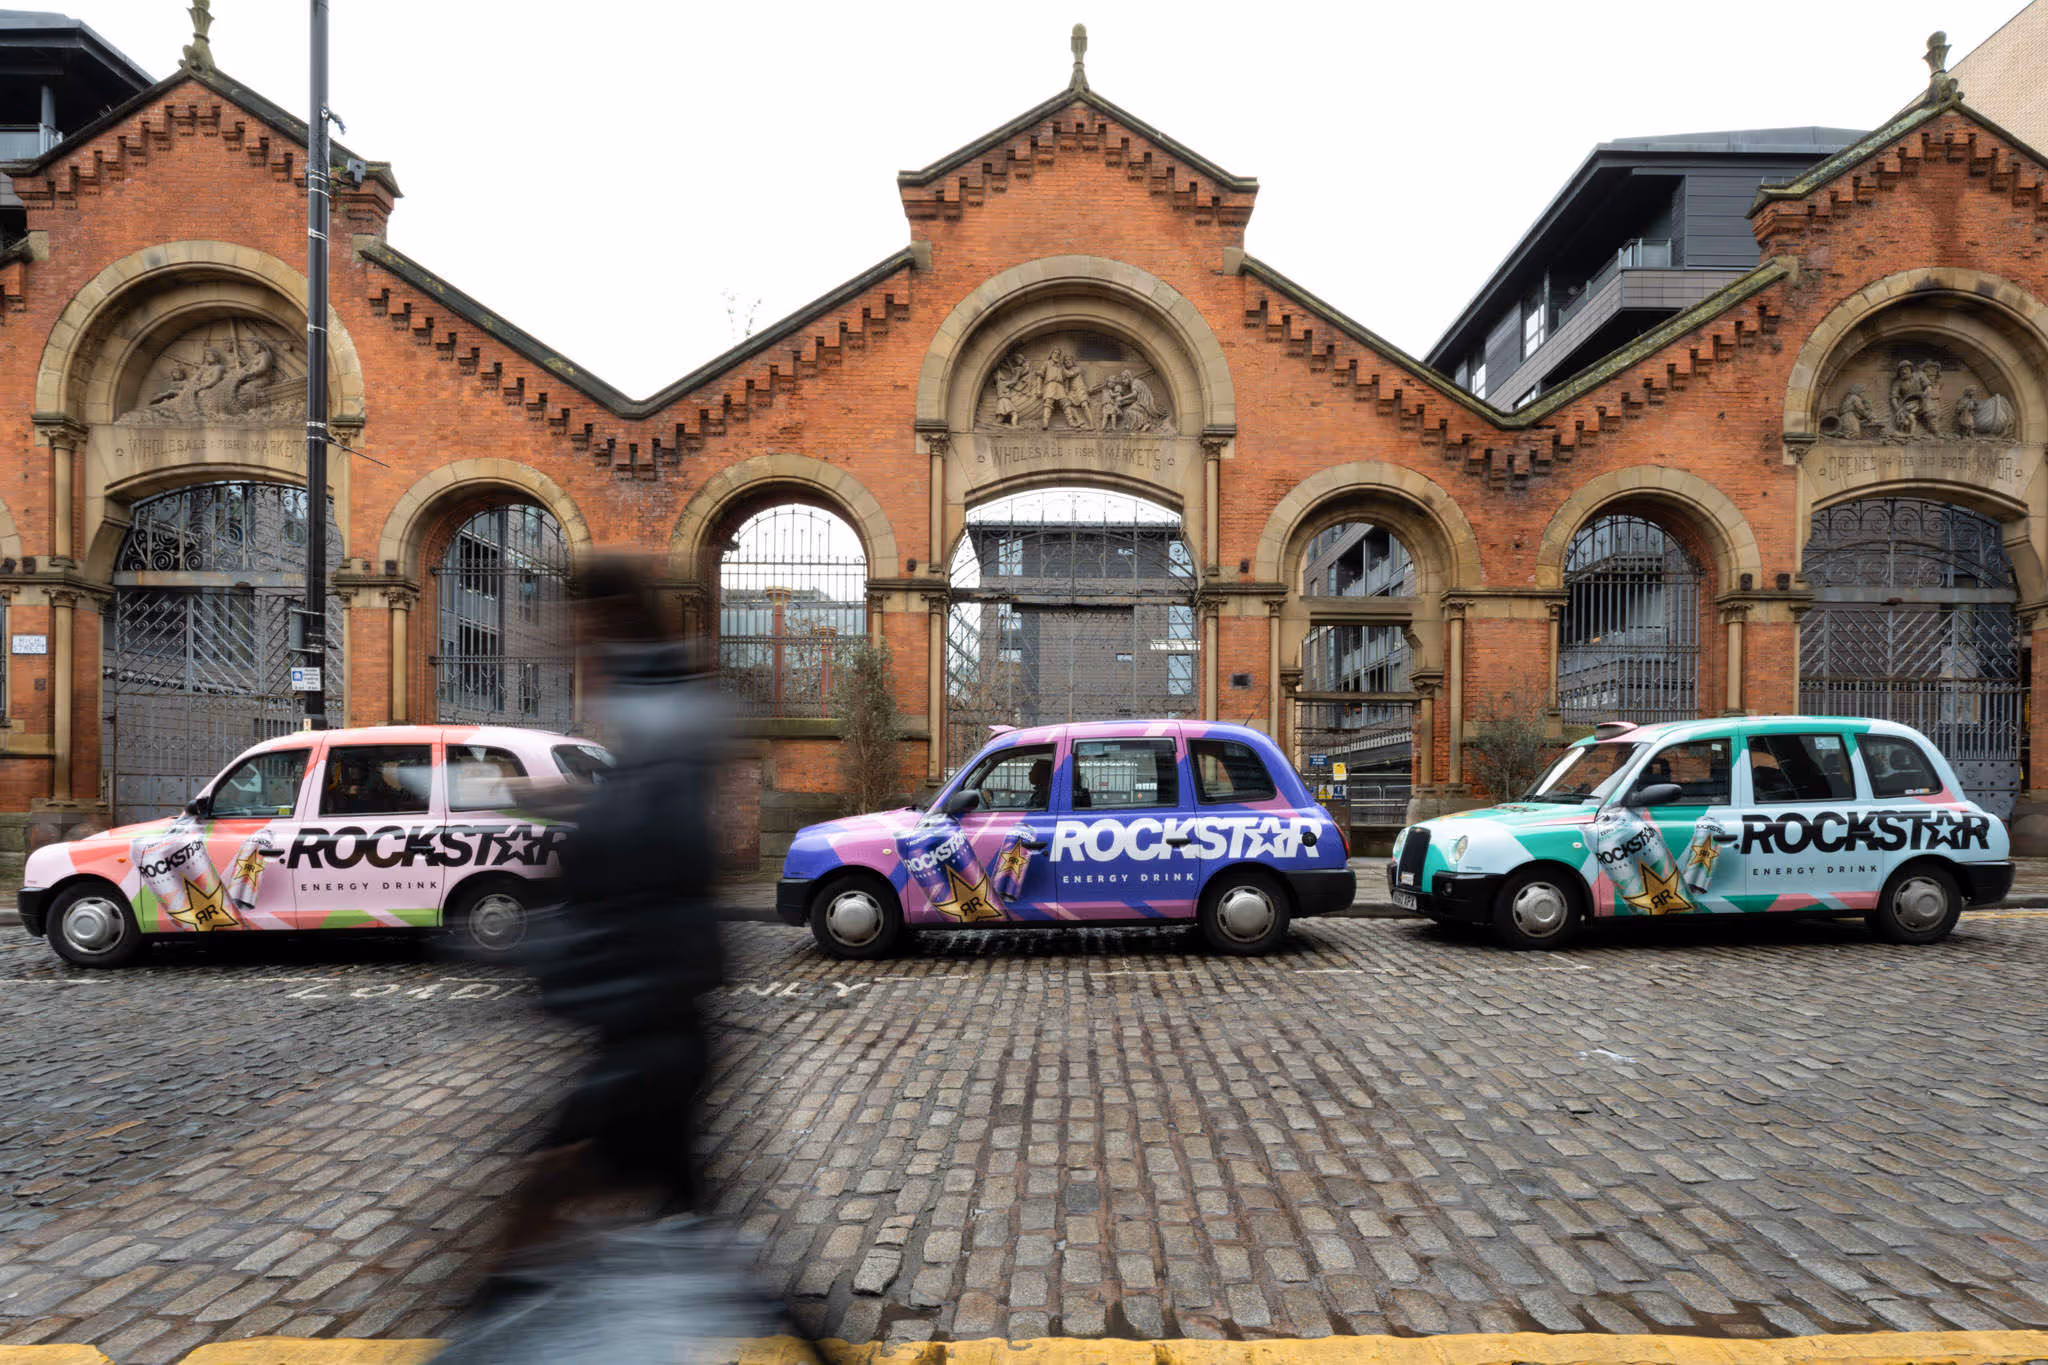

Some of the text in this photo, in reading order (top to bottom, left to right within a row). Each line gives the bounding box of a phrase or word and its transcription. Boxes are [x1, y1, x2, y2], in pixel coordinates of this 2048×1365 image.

[129, 439, 206, 465] WHOLESALE
[991, 446, 1063, 466] WHOLESALE
[1104, 447, 1161, 472] MARKETS
[1050, 816, 1323, 863] ROCKSTAR
[1740, 810, 1990, 855] ROCKSTAR
[1062, 872, 1195, 884] ENERGY DRINK
[1752, 864, 1878, 876] ENERGY DRINK
[301, 881, 437, 892] ENERGY DRINK
[728, 981, 870, 998] NLY
